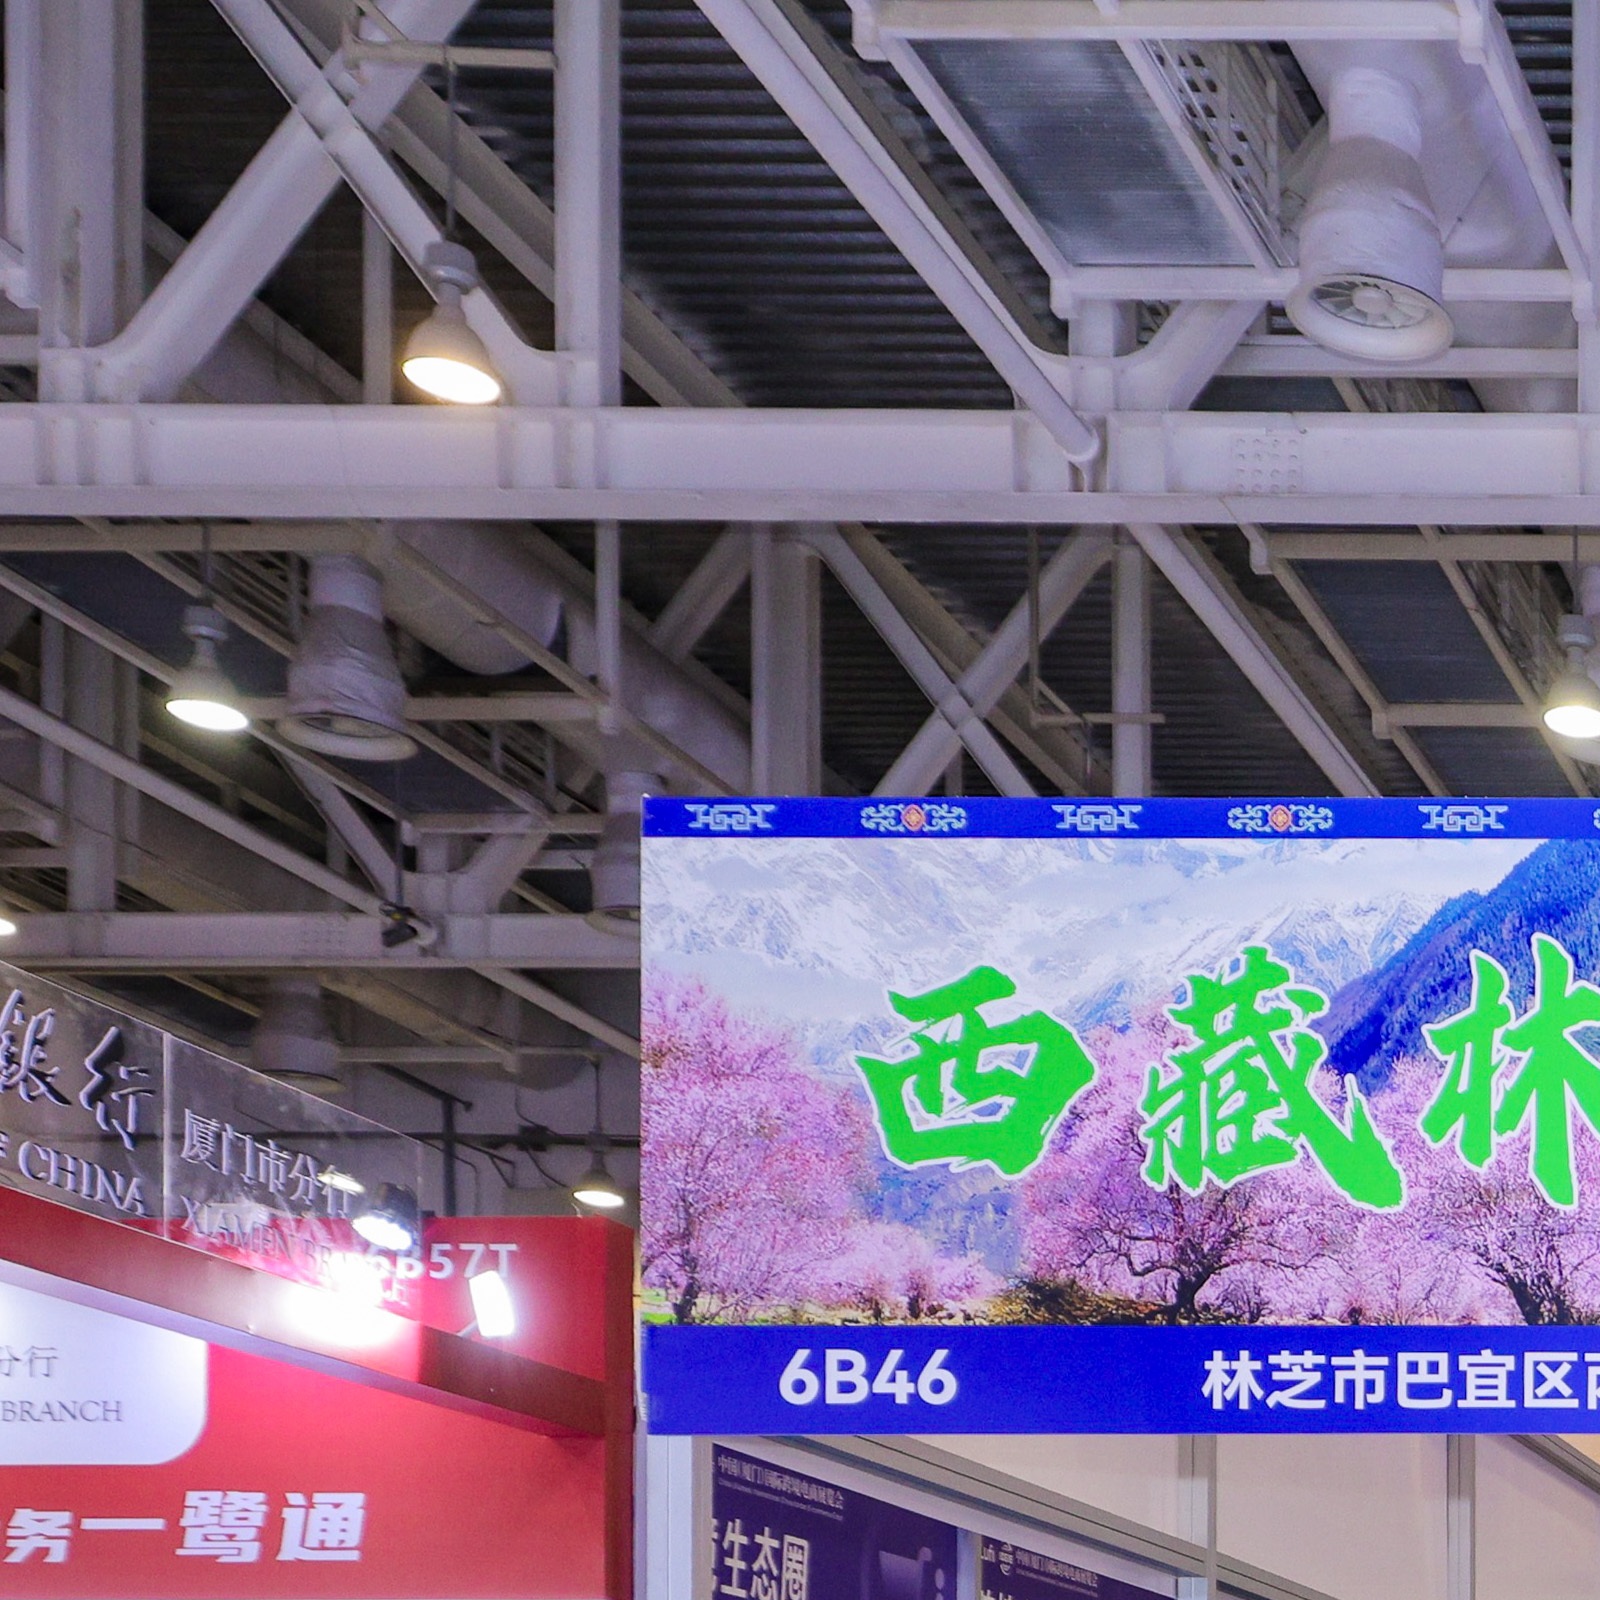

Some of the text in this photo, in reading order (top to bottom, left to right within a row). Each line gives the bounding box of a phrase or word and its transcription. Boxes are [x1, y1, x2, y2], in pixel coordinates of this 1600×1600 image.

[18, 1140, 148, 1217] CHINA
[181, 1108, 353, 1219] 厦门市分行
[778, 1348, 958, 1406] 6B46
[3, 1490, 366, 1563] 务一鹭通
